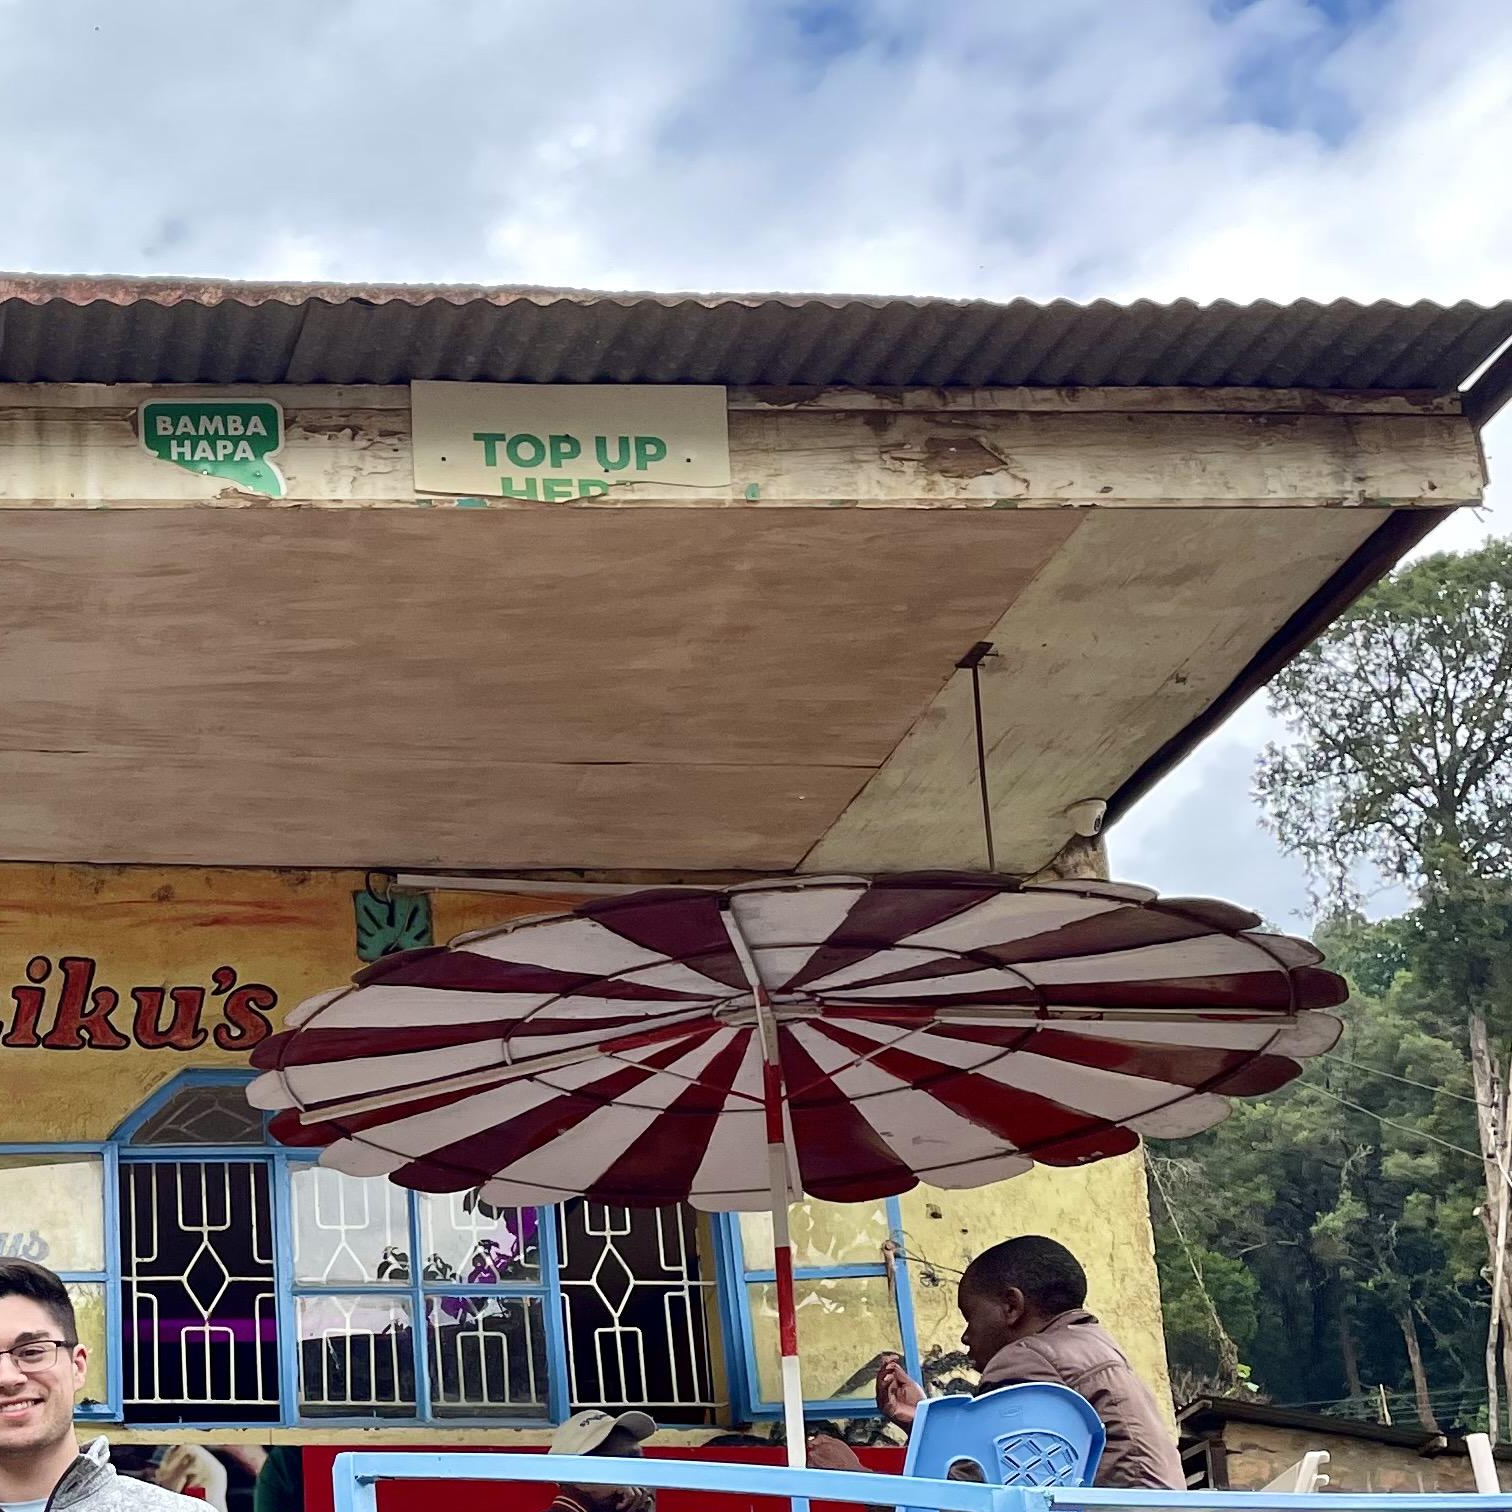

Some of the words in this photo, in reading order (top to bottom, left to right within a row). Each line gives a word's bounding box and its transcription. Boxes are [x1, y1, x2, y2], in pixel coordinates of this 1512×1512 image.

[156, 415, 267, 436] BAMBA
[170, 440, 255, 461] HAPA
[473, 432, 582, 469] TOP
[595, 436, 668, 471] UP
